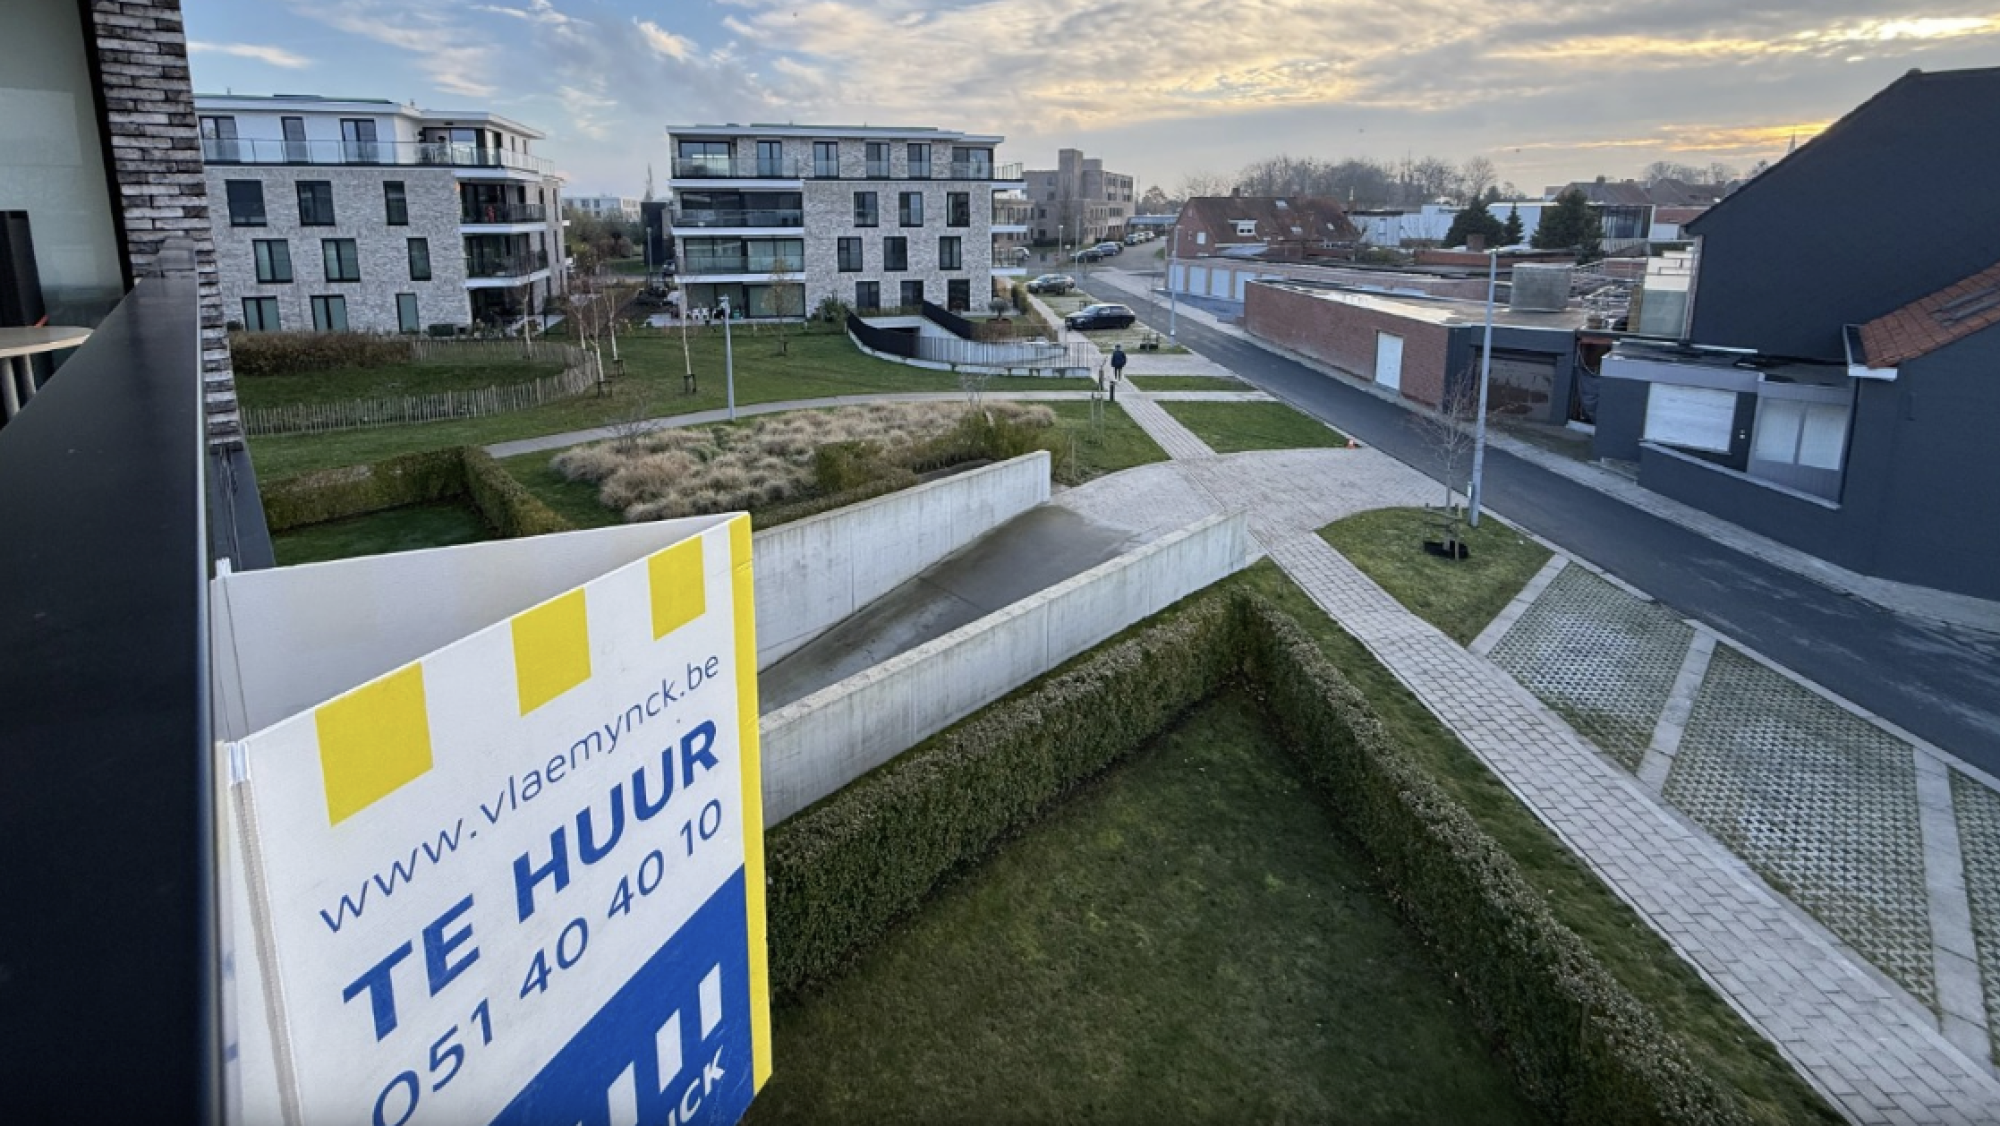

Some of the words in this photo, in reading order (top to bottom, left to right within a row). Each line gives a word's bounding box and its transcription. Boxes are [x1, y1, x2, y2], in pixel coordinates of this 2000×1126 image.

[319, 655, 720, 934] www.vlaemynck.be
[342, 893, 481, 1042] TE
[511, 718, 719, 924] HUUR
[372, 998, 493, 1126] 051
[519, 917, 590, 1000] 40
[607, 849, 665, 919] 40
[680, 799, 723, 858] 10
